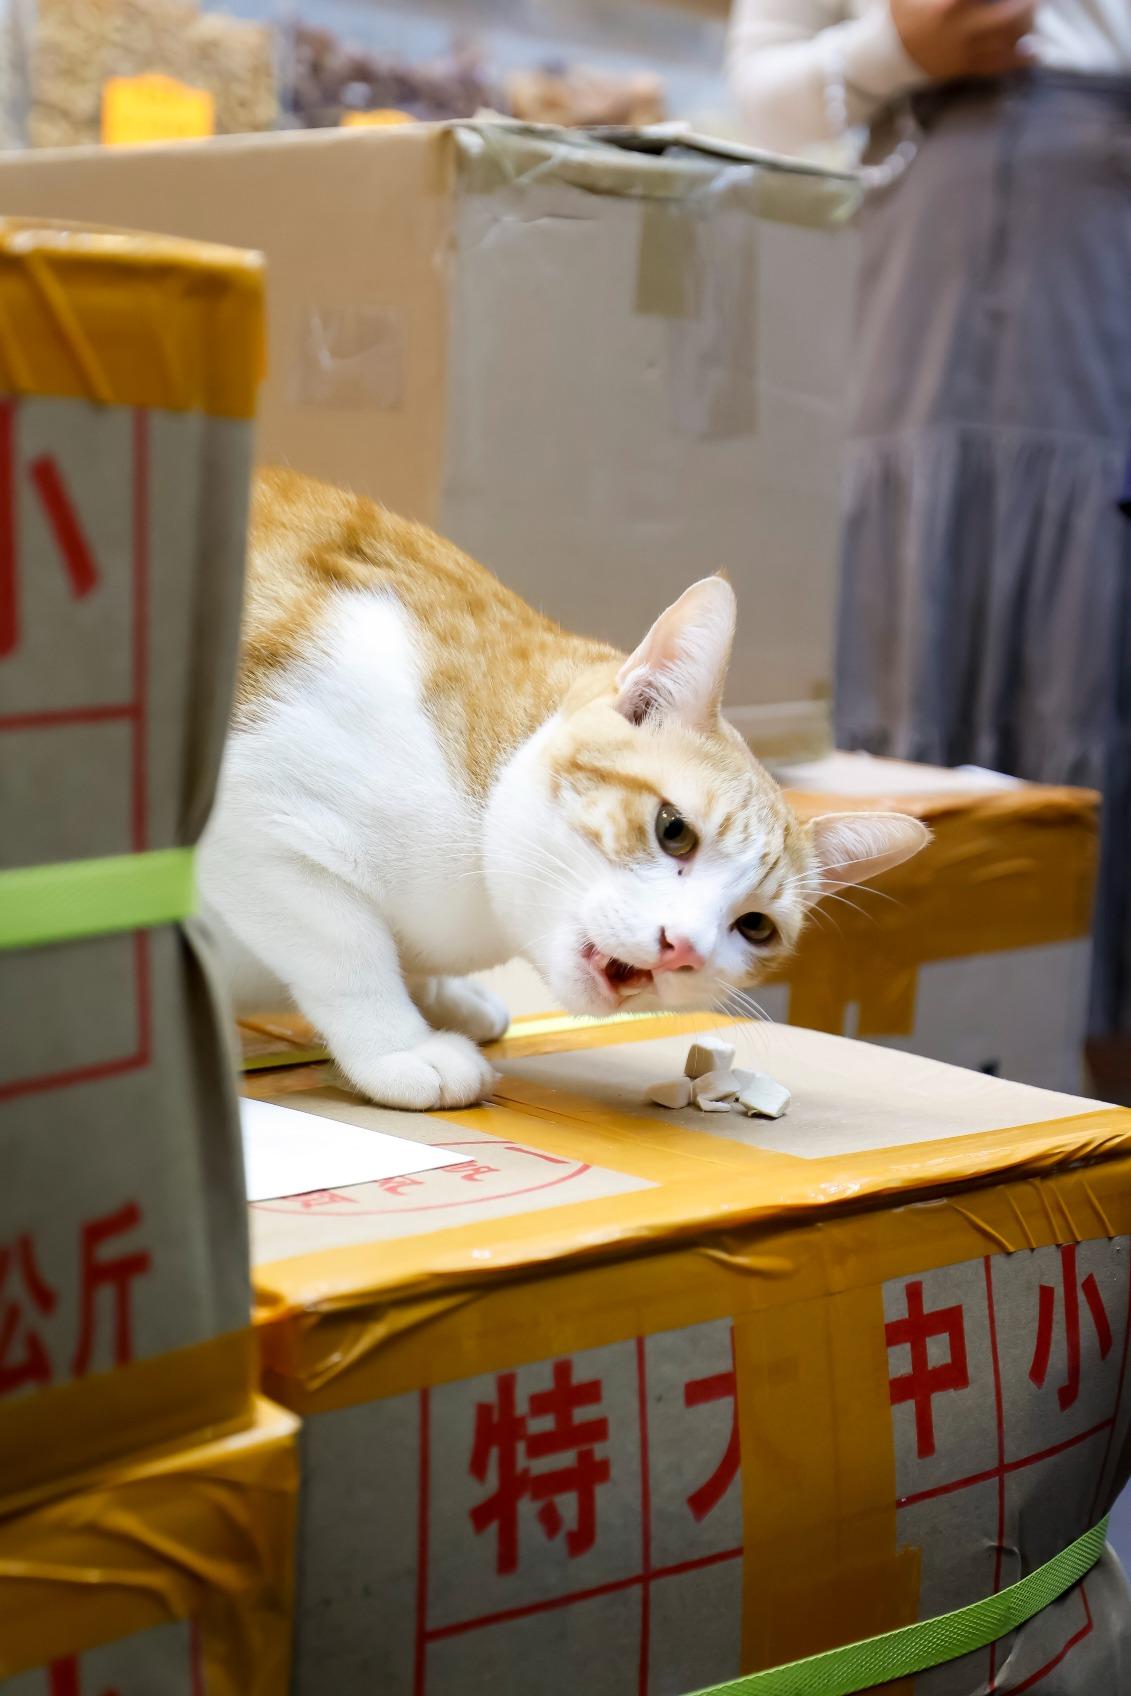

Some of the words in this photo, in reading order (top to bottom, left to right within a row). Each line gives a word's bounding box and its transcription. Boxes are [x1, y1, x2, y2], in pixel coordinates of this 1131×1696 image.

[468, 1358, 612, 1576] 特
[885, 1281, 971, 1459] 中
[1029, 1243, 1113, 1412] 小
